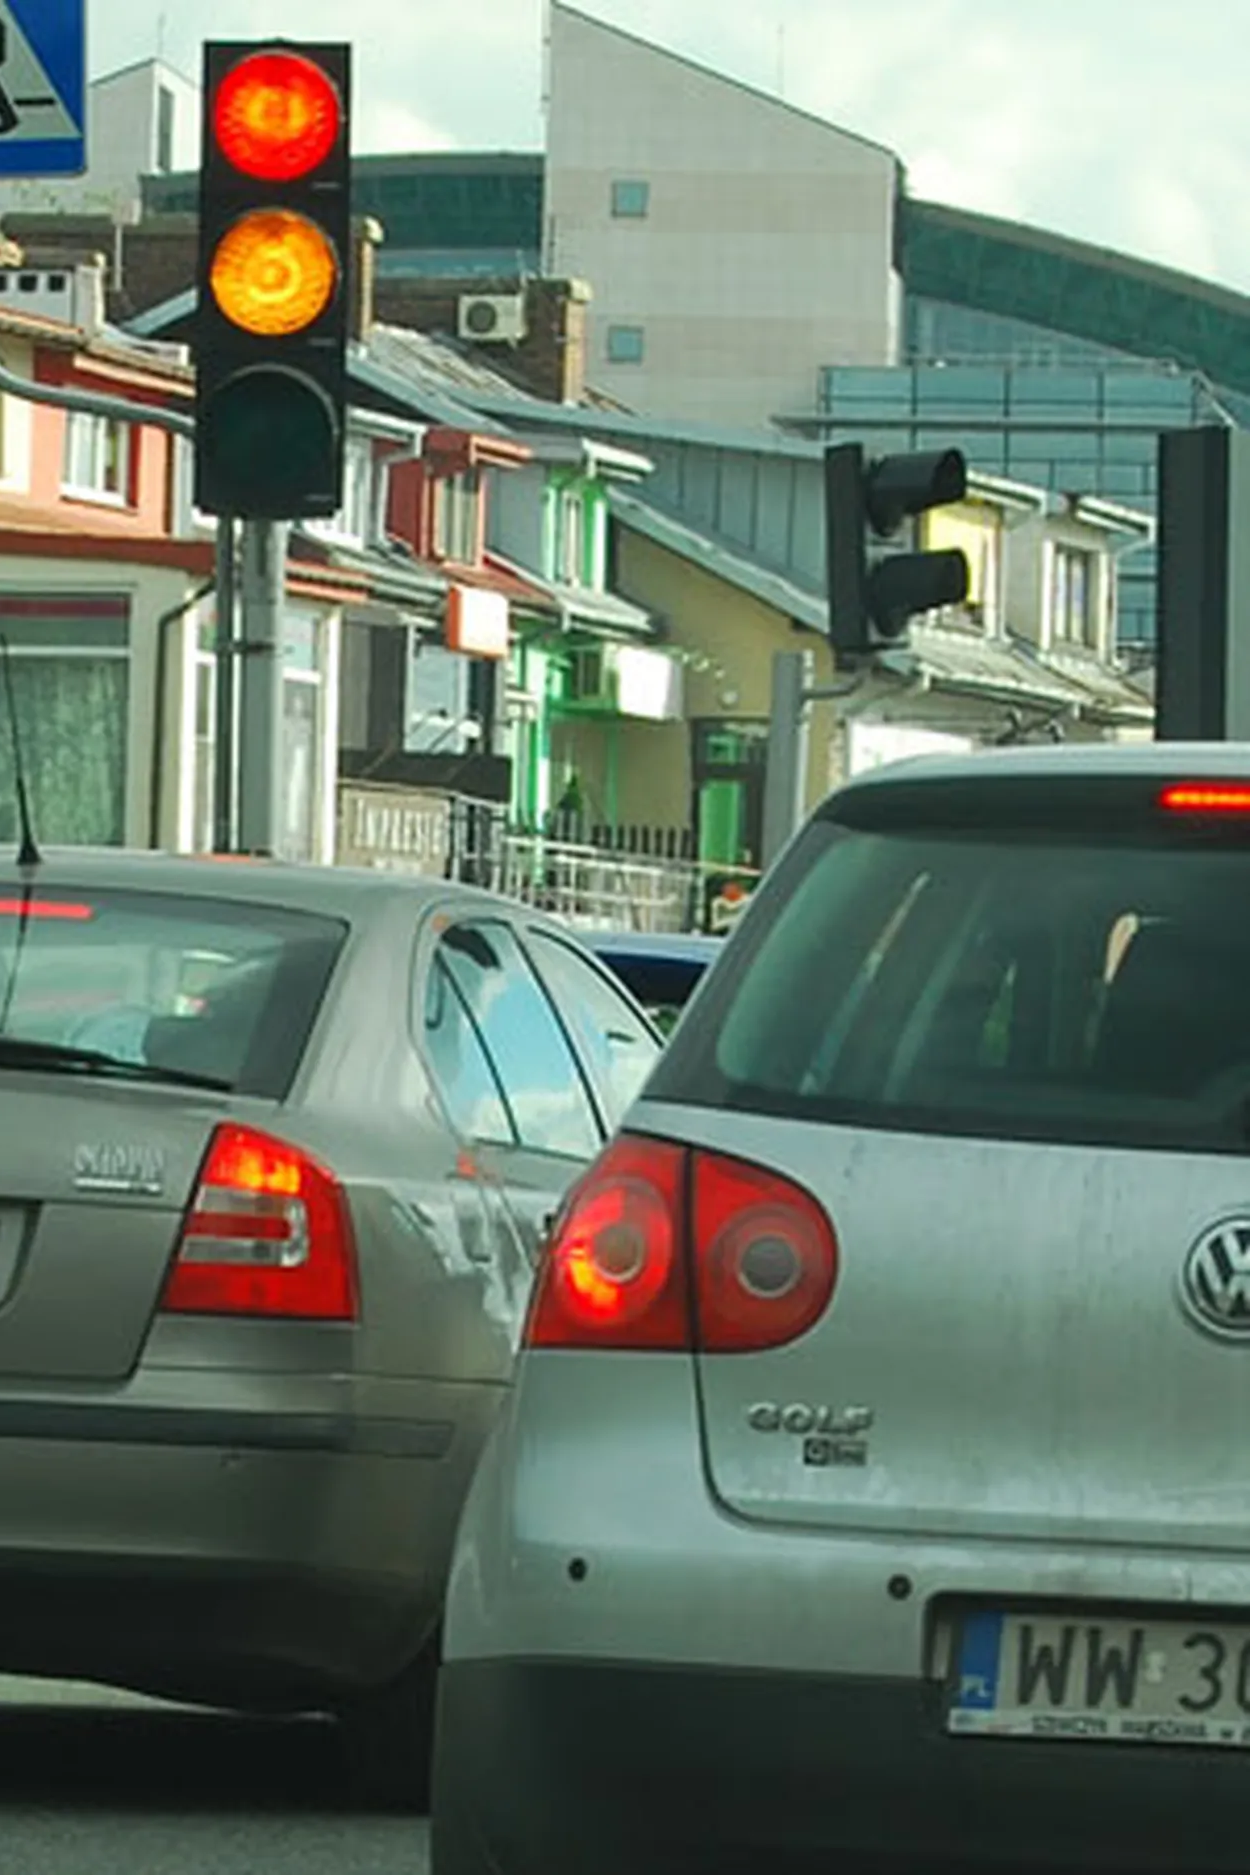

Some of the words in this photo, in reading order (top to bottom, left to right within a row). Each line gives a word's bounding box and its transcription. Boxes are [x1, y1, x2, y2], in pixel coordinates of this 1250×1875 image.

[748, 1402, 874, 1435] GOLF
[1016, 1623, 1145, 1708] WW
[1178, 1631, 1250, 1714] 3
